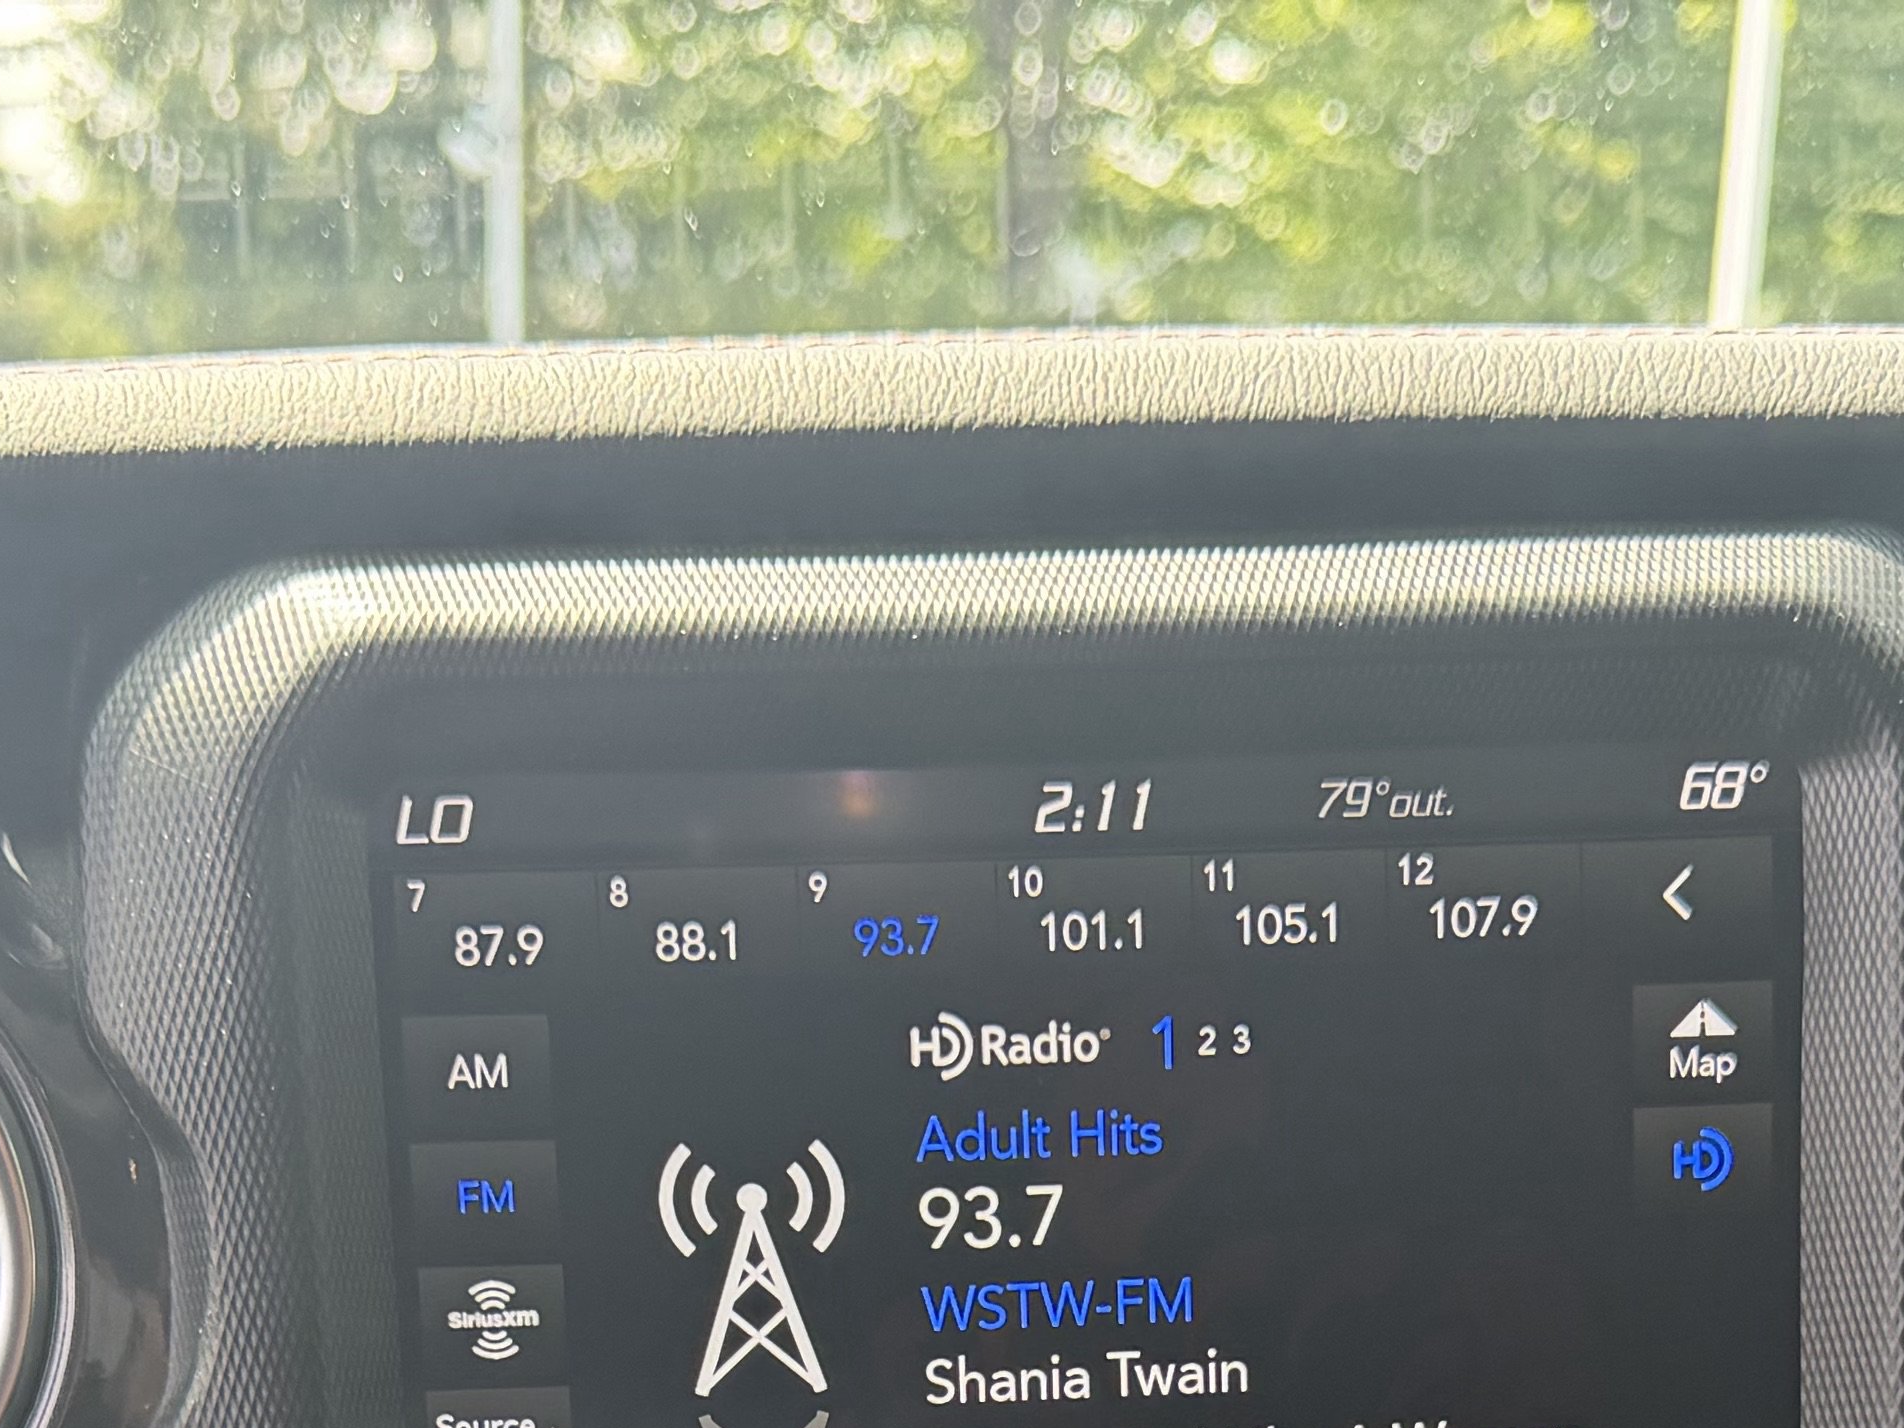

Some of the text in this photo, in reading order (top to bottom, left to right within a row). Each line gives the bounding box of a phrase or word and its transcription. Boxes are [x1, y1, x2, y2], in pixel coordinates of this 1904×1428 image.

[1035, 779, 1152, 834] 2:11
[1680, 760, 1770, 811] 68°
[397, 795, 474, 845] LO
[808, 871, 828, 902] 9
[1008, 866, 1044, 898] 10
[1203, 858, 1235, 892] 11
[1398, 853, 1434, 886] 12
[407, 880, 426, 912] 7
[609, 876, 629, 908] 8
[854, 915, 940, 957] 93.7
[1041, 909, 1145, 951] 101.1
[1235, 902, 1338, 945] 105.1
[1429, 896, 1538, 939] 107.9
[454, 925, 544, 966] 87.9
[655, 921, 738, 961] 88.1
[1152, 1015, 1251, 1071] 1 2 3
[448, 1054, 509, 1090] AM
[1669, 1048, 1737, 1082] Map
[916, 1108, 1164, 1163] Adult Hits
[457, 1179, 516, 1213] FM
[918, 1184, 1064, 1250] 93.7
[921, 1277, 1194, 1332] WSTW-FM
[925, 1349, 1249, 1405] Shania Twain
